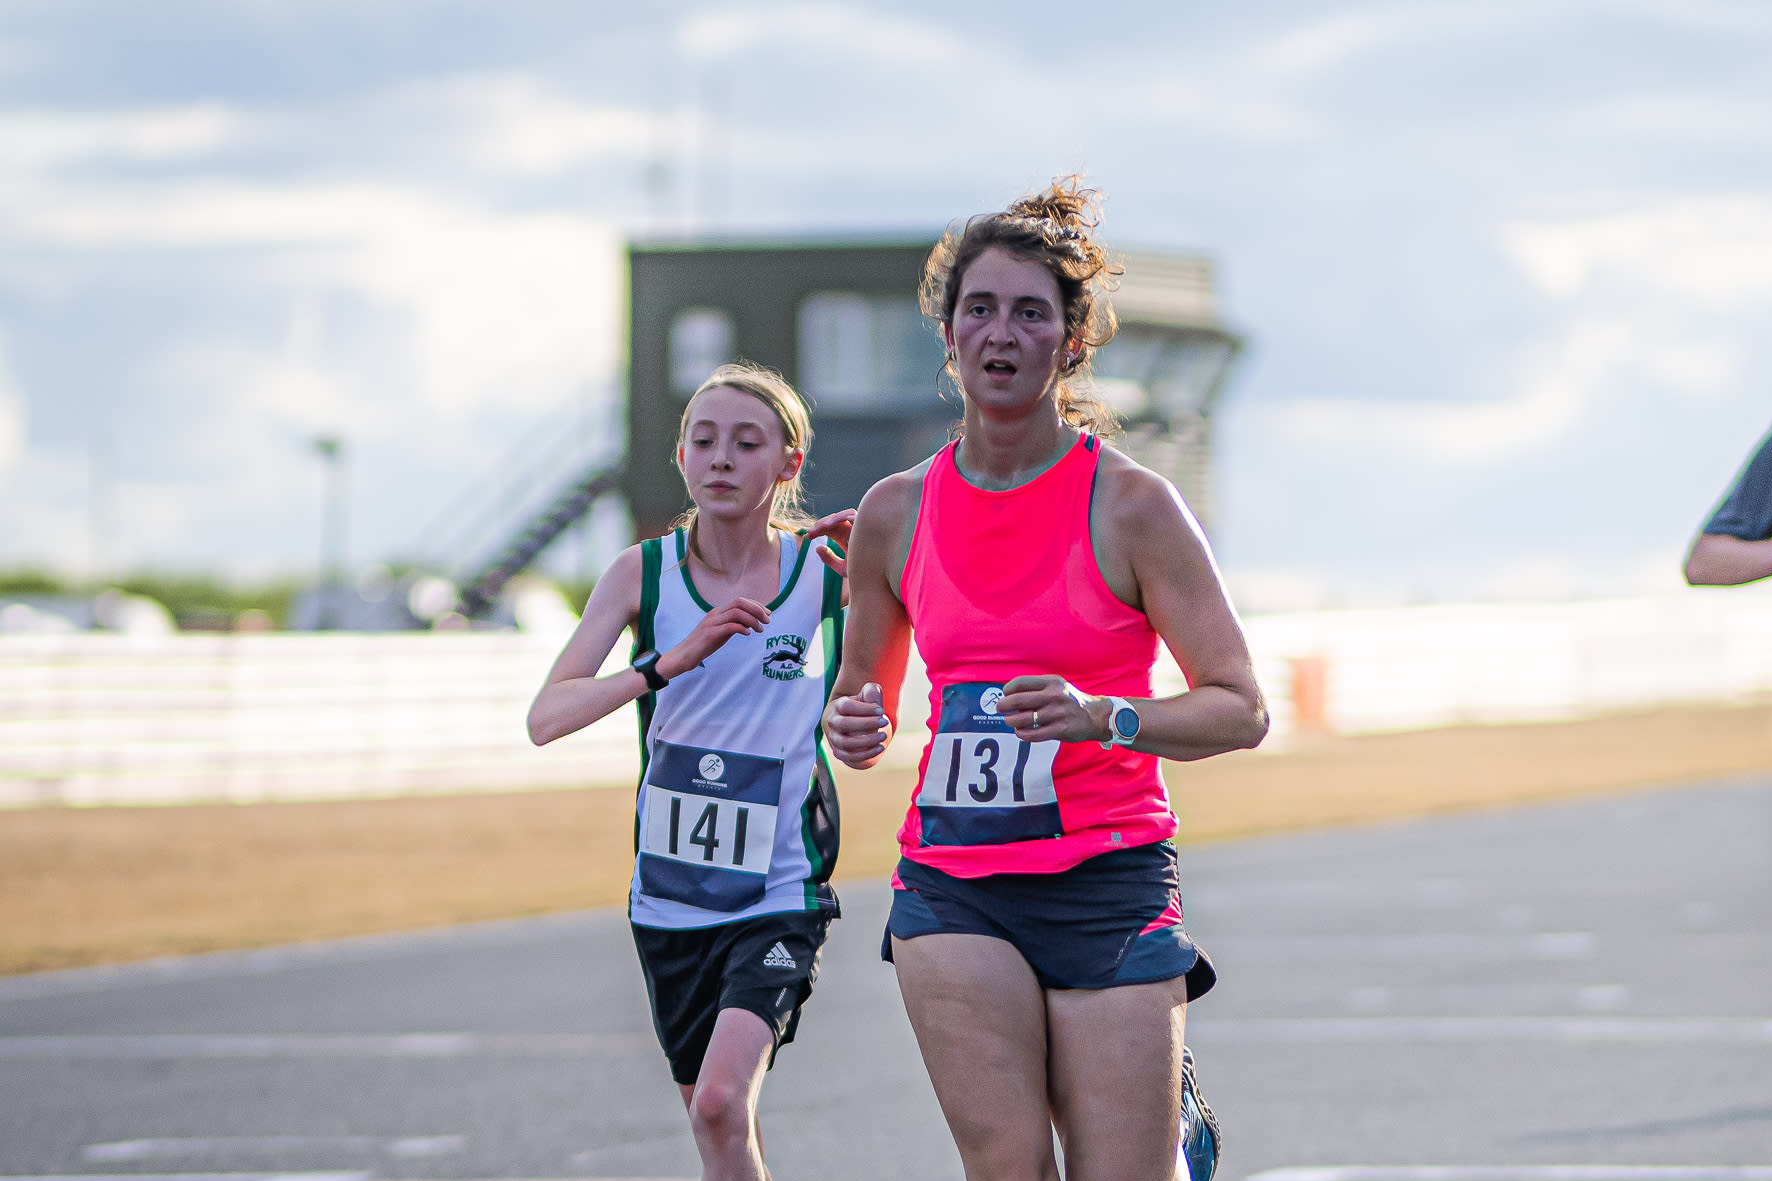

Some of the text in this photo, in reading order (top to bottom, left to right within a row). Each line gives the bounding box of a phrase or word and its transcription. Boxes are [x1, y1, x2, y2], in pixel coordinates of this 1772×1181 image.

[762, 663, 805, 681] RUNNERS
[945, 738, 1031, 802] 131
[669, 796, 749, 866] 141
[763, 957, 797, 969] adidas
